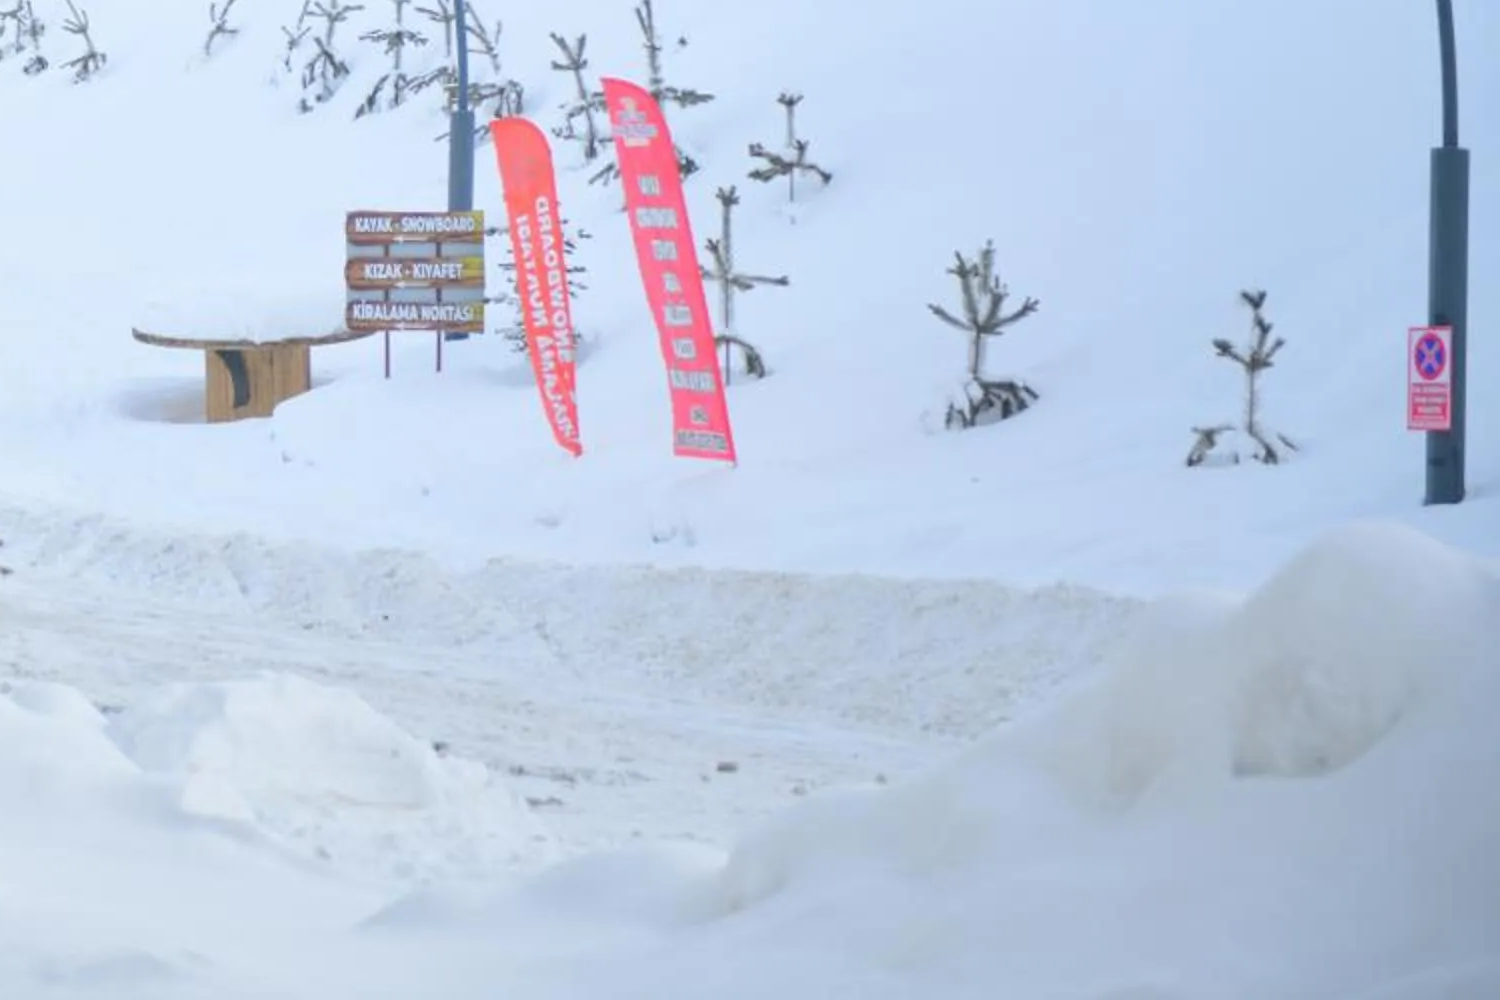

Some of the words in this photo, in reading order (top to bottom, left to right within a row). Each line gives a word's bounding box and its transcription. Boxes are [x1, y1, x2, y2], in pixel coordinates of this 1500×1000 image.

[355, 216, 393, 233] KAYAK
[401, 216, 475, 233] SNOWBOARD
[364, 263, 403, 279] KIZAK
[412, 263, 463, 279] KIYAFET
